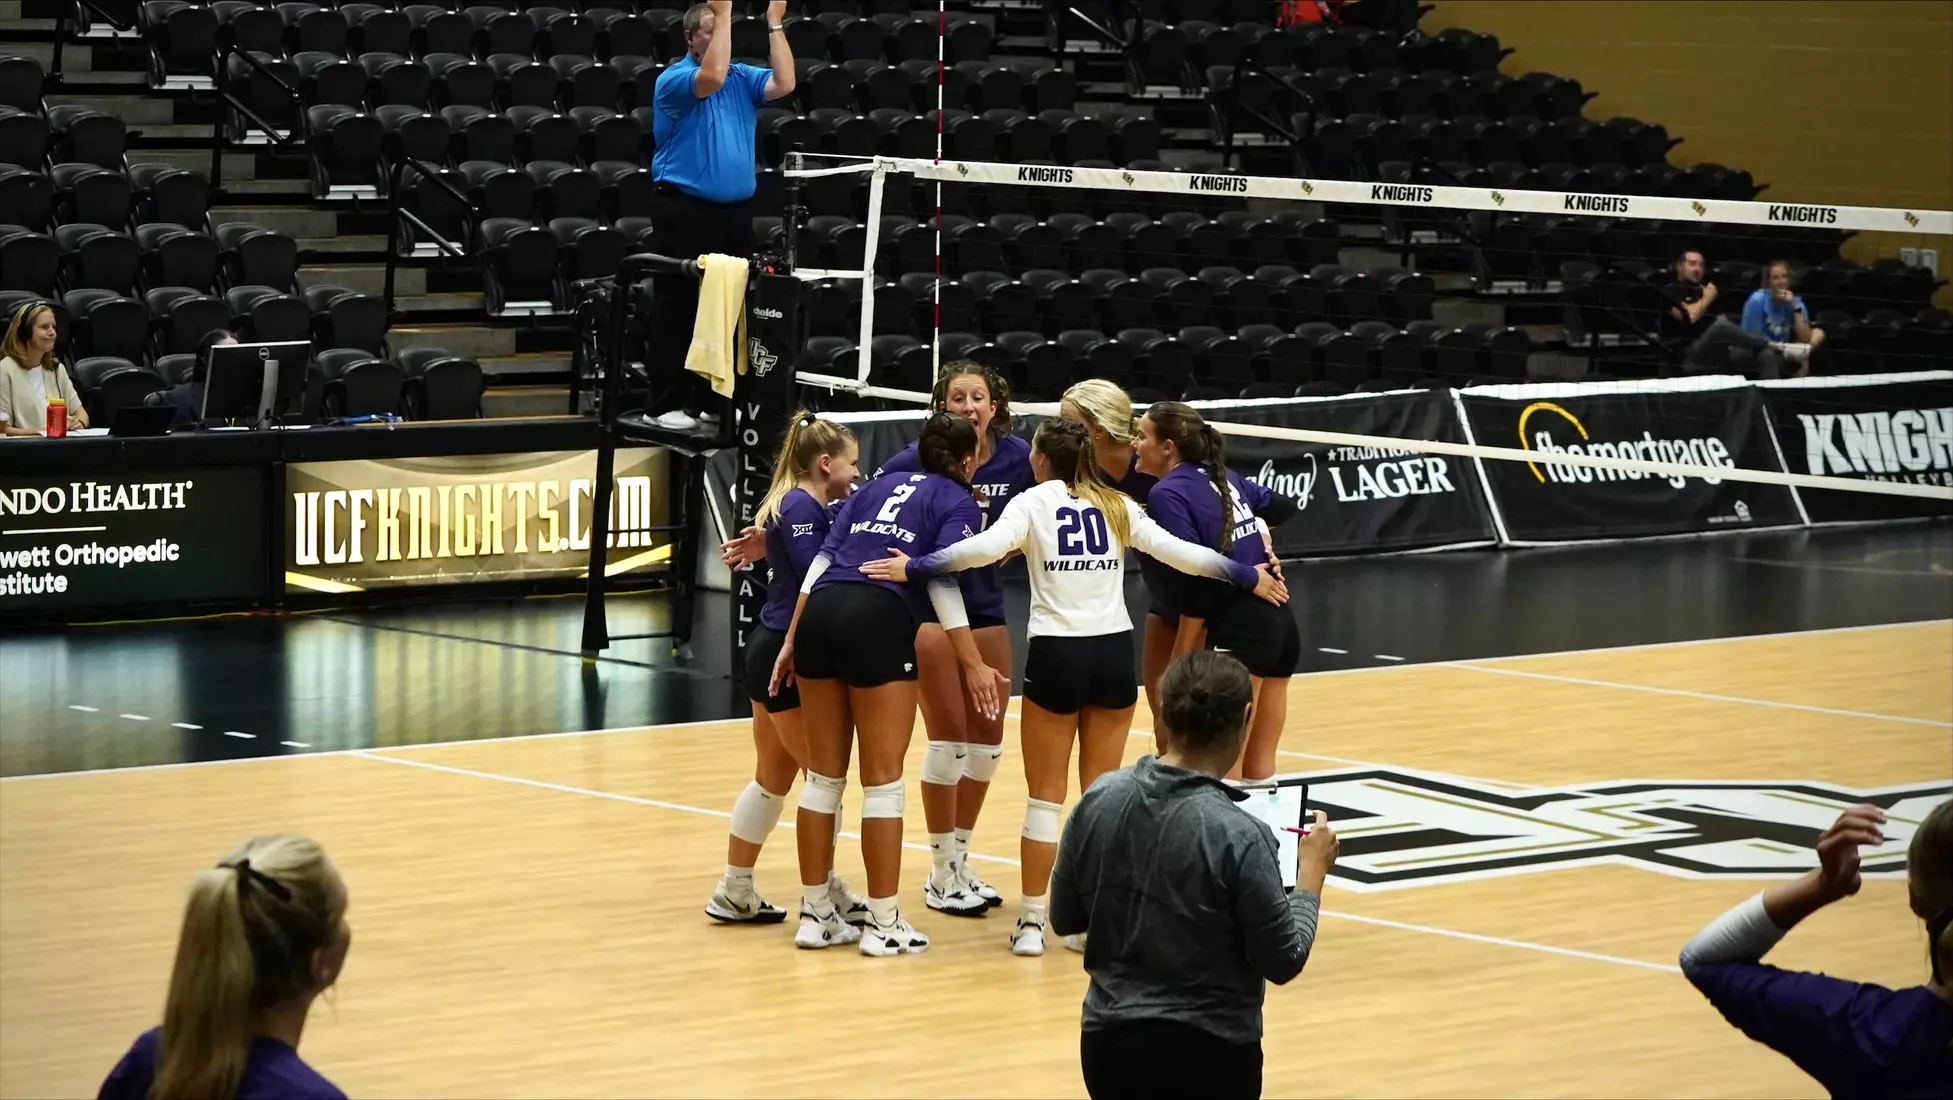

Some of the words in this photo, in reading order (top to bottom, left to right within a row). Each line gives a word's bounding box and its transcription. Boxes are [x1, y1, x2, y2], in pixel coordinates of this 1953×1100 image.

[1018, 166, 1073, 183] KNIGHTS
[1189, 175, 1248, 192] KNIGHTS
[1371, 185, 1433, 202] KNIGHTS
[1564, 195, 1629, 213] KNIGHTS
[1768, 205, 1838, 223] KNIGHTS
[1796, 407, 1953, 476] KNIGH
[971, 483, 1010, 497] ATE
[1328, 456, 1456, 502] LAGER
[0, 487, 66, 516] NDO
[293, 475, 653, 566] UCFKNIGHTS.CM
[875, 482, 917, 523] 2
[737, 402, 760, 648] VOLLEALL
[1055, 506, 1110, 556] 20
[0, 546, 50, 569] wett
[55, 538, 180, 569] Orthopedic
[1043, 559, 1119, 572] WILDCATS
[0, 571, 68, 596] stitute
